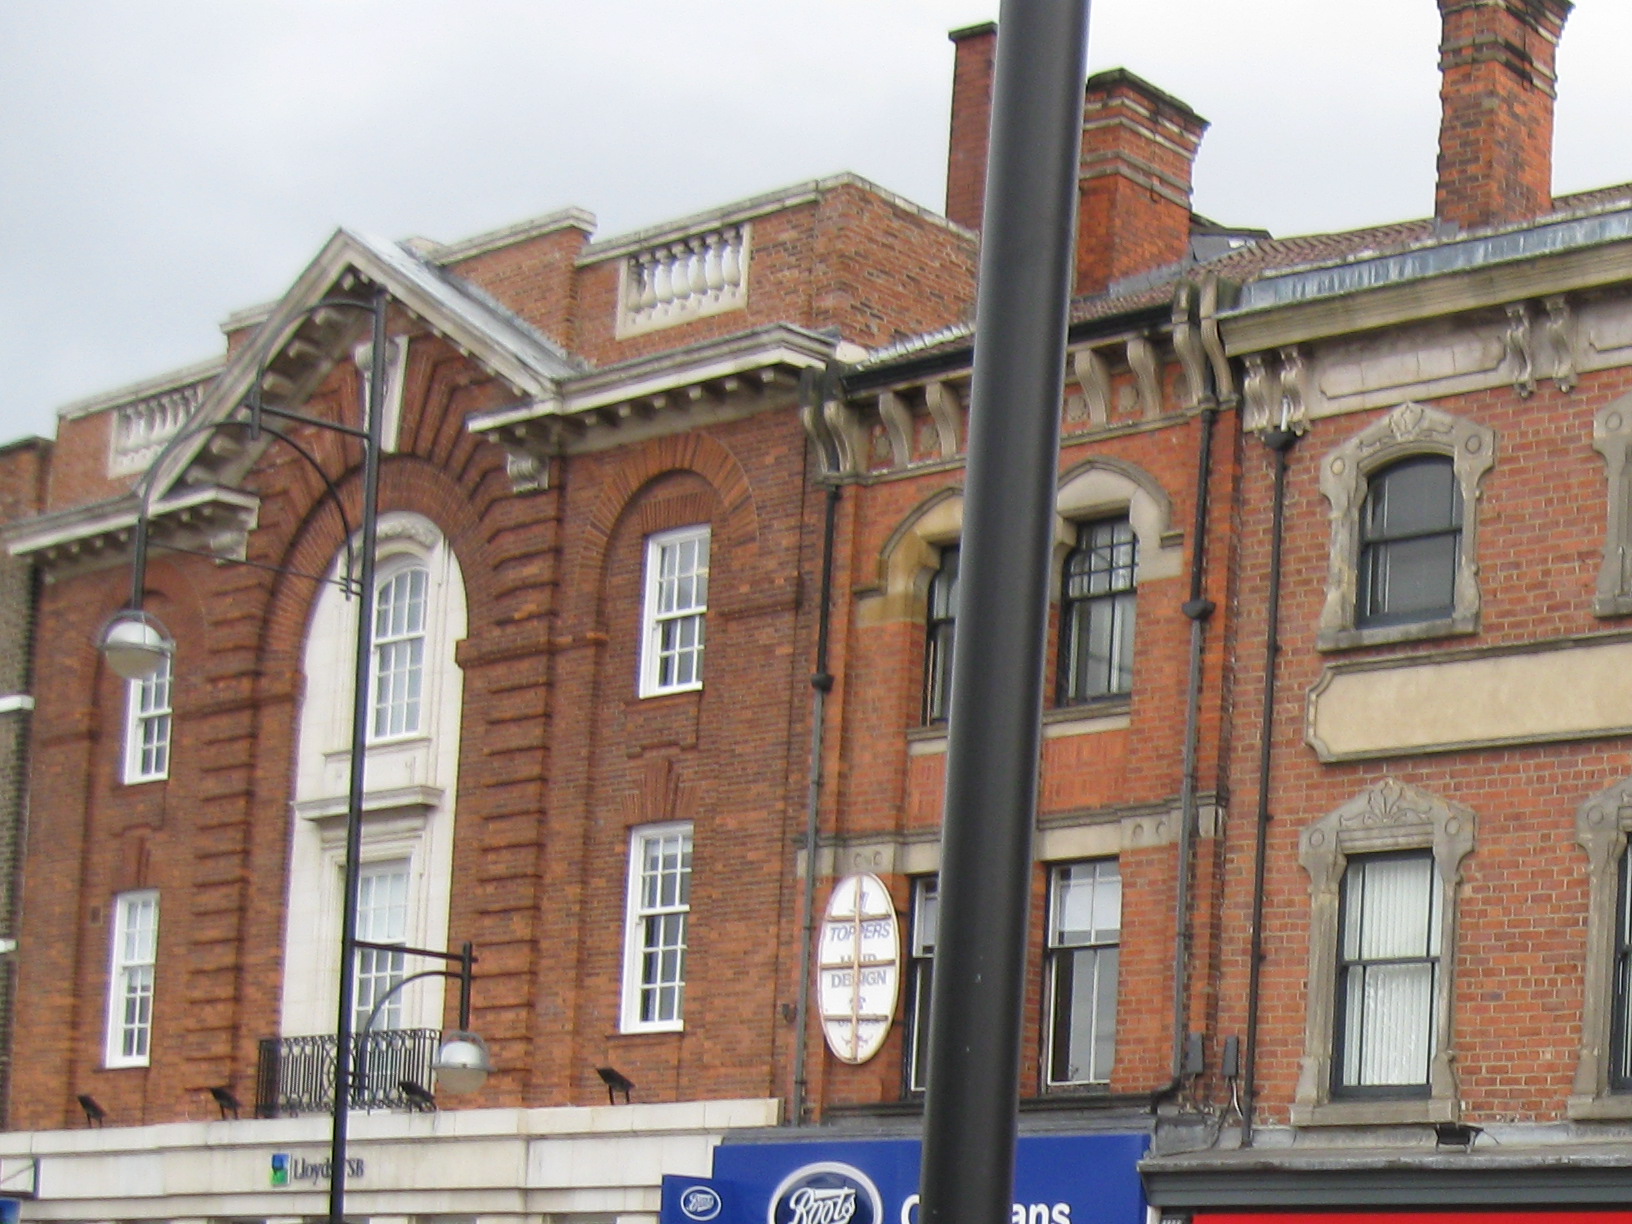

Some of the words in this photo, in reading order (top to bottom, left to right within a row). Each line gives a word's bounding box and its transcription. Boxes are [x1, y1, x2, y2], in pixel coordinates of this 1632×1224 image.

[830, 922, 891, 942] TOPERS
[831, 969, 887, 988] DEIGN
[293, 1157, 334, 1185] Lloyd
